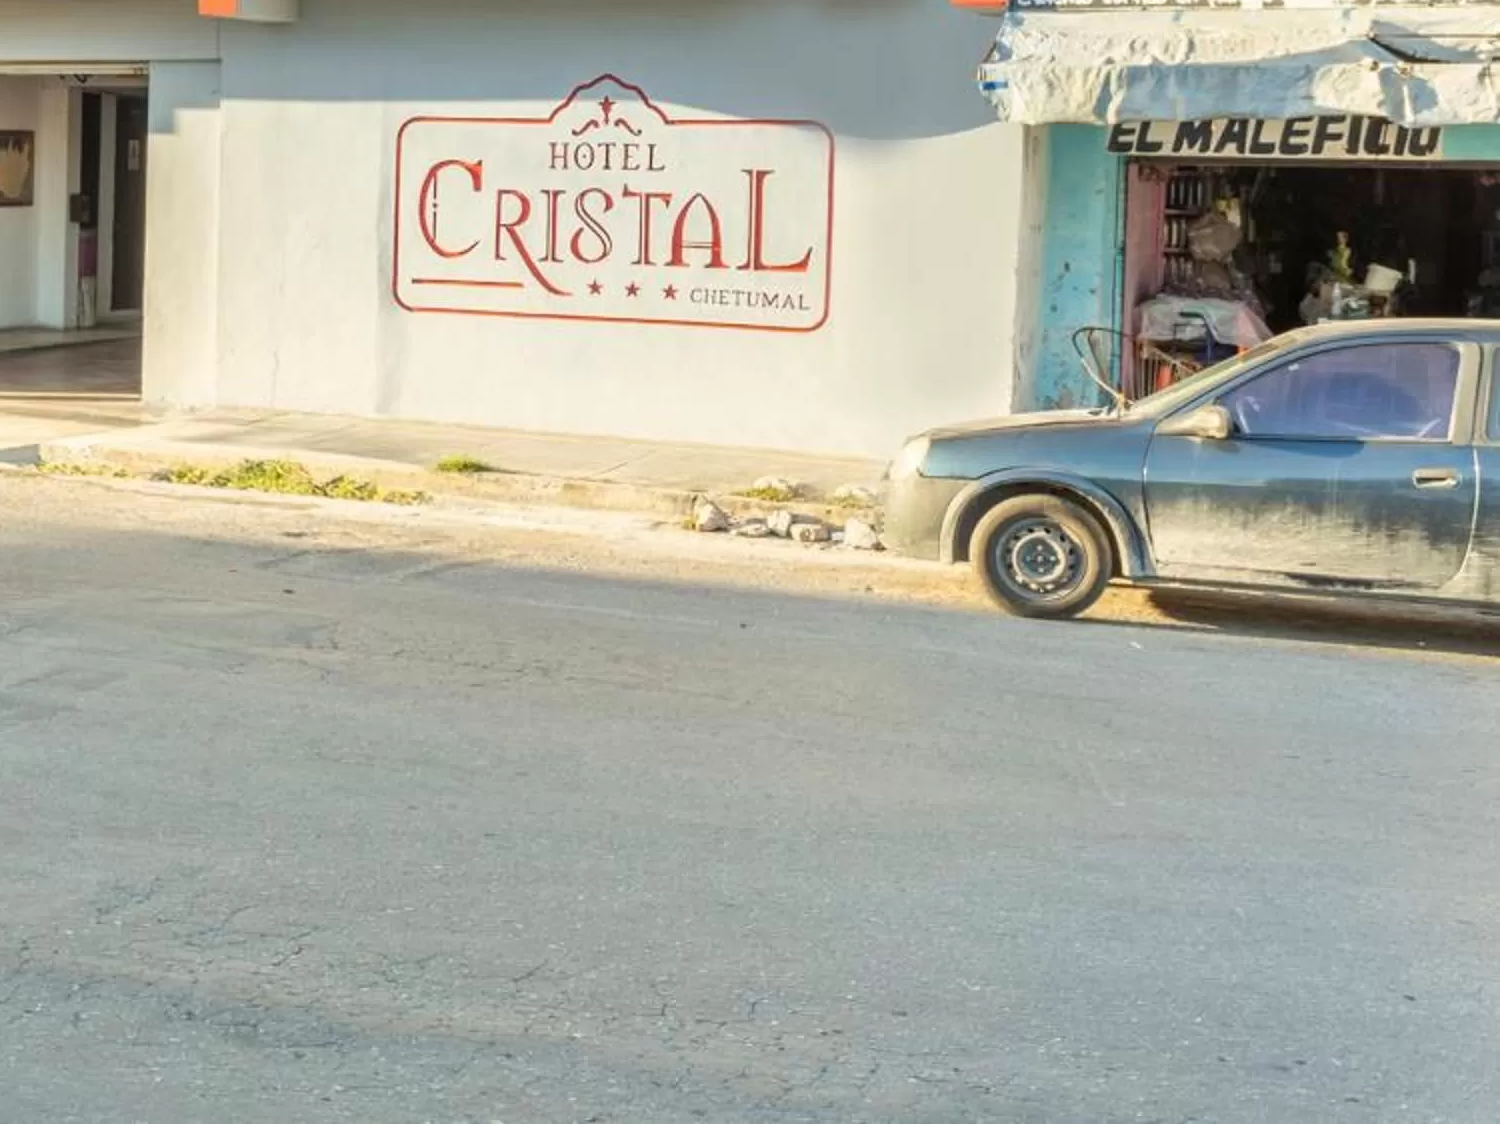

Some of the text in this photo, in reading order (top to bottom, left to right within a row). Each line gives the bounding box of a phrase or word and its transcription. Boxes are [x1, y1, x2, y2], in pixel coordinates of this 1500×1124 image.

[1107, 115, 1441, 157] EL MALEFICIO
[547, 141, 666, 172] HOTEL
[418, 159, 813, 296] CRISTAL
[689, 287, 811, 311] CHETUMAL
